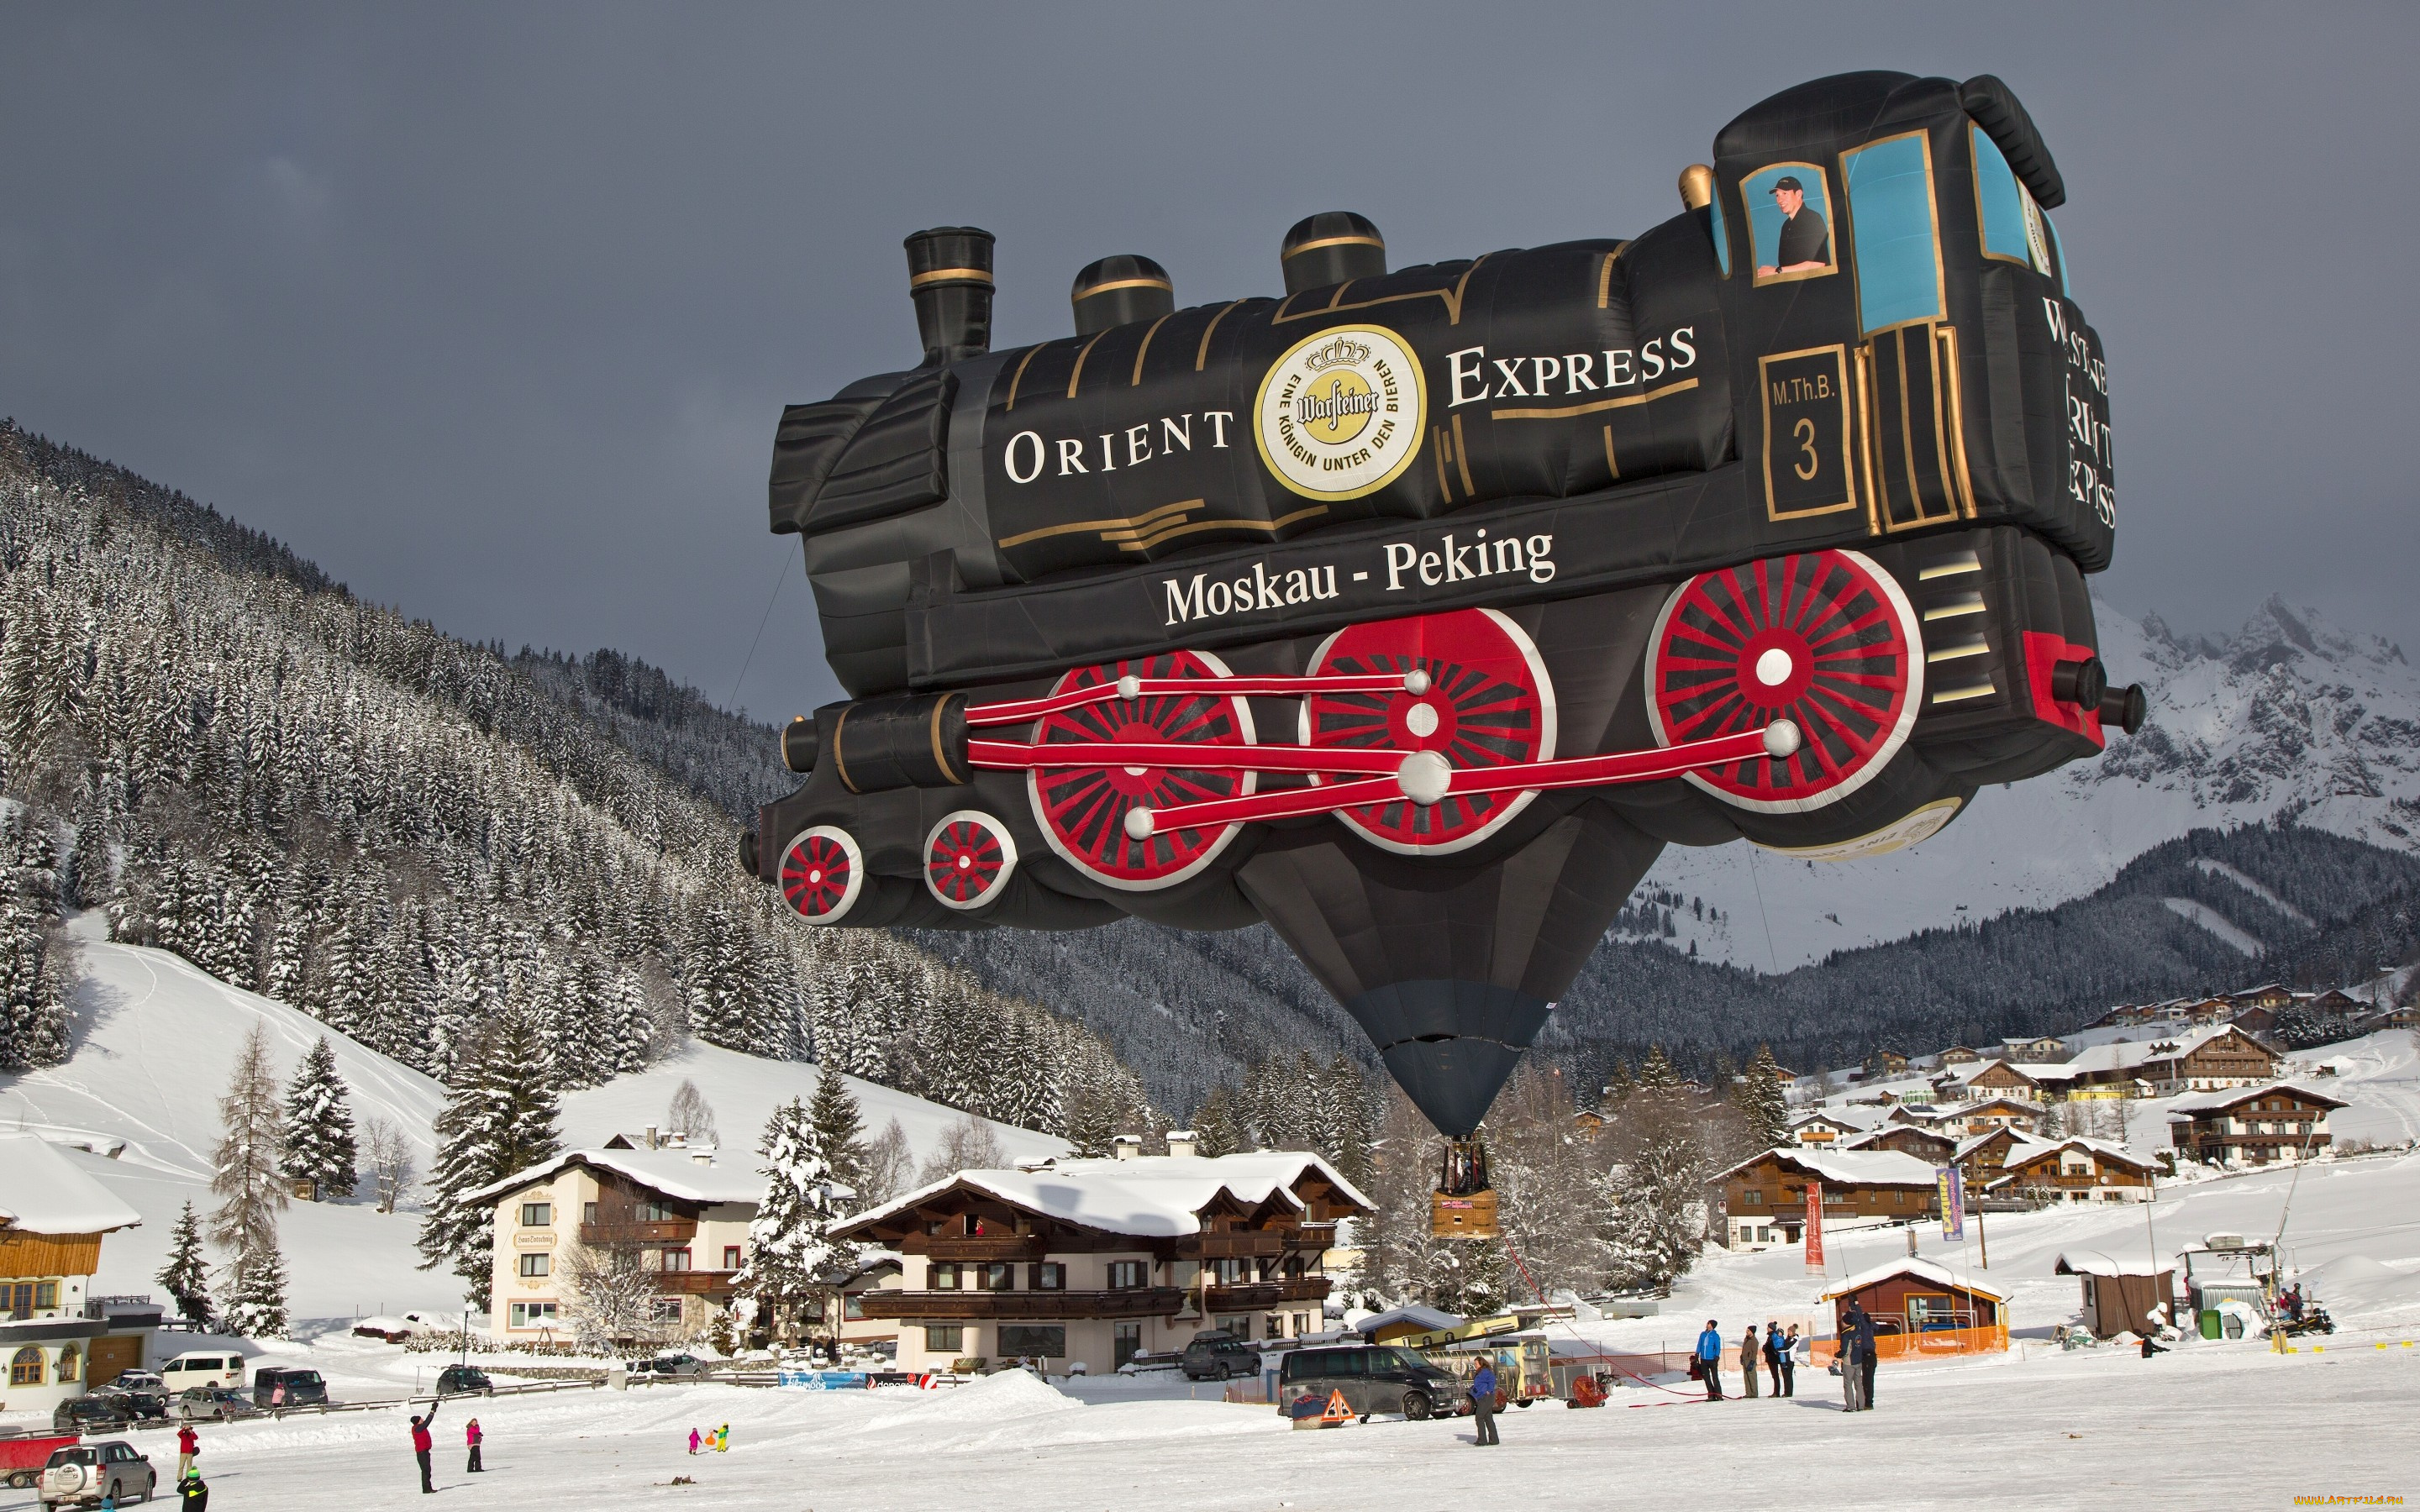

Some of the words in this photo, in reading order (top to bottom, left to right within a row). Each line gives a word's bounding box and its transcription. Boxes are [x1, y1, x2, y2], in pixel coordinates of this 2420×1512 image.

[1004, 411, 1234, 485] ORIENT
[1445, 325, 1697, 408] EXPRESS
[1279, 374, 1302, 409] EINE
[1297, 379, 1380, 432] Warsteiner
[1373, 359, 1398, 413] BIEREN
[1772, 374, 1836, 406] M.Th.B.
[1278, 414, 1318, 468] KÖNIGIN
[1323, 447, 1371, 471] UNTER
[1370, 419, 1396, 449] DEN
[1793, 417, 1819, 480] 3
[1162, 562, 1339, 626] Moskau
[1383, 528, 1556, 591] Peking
